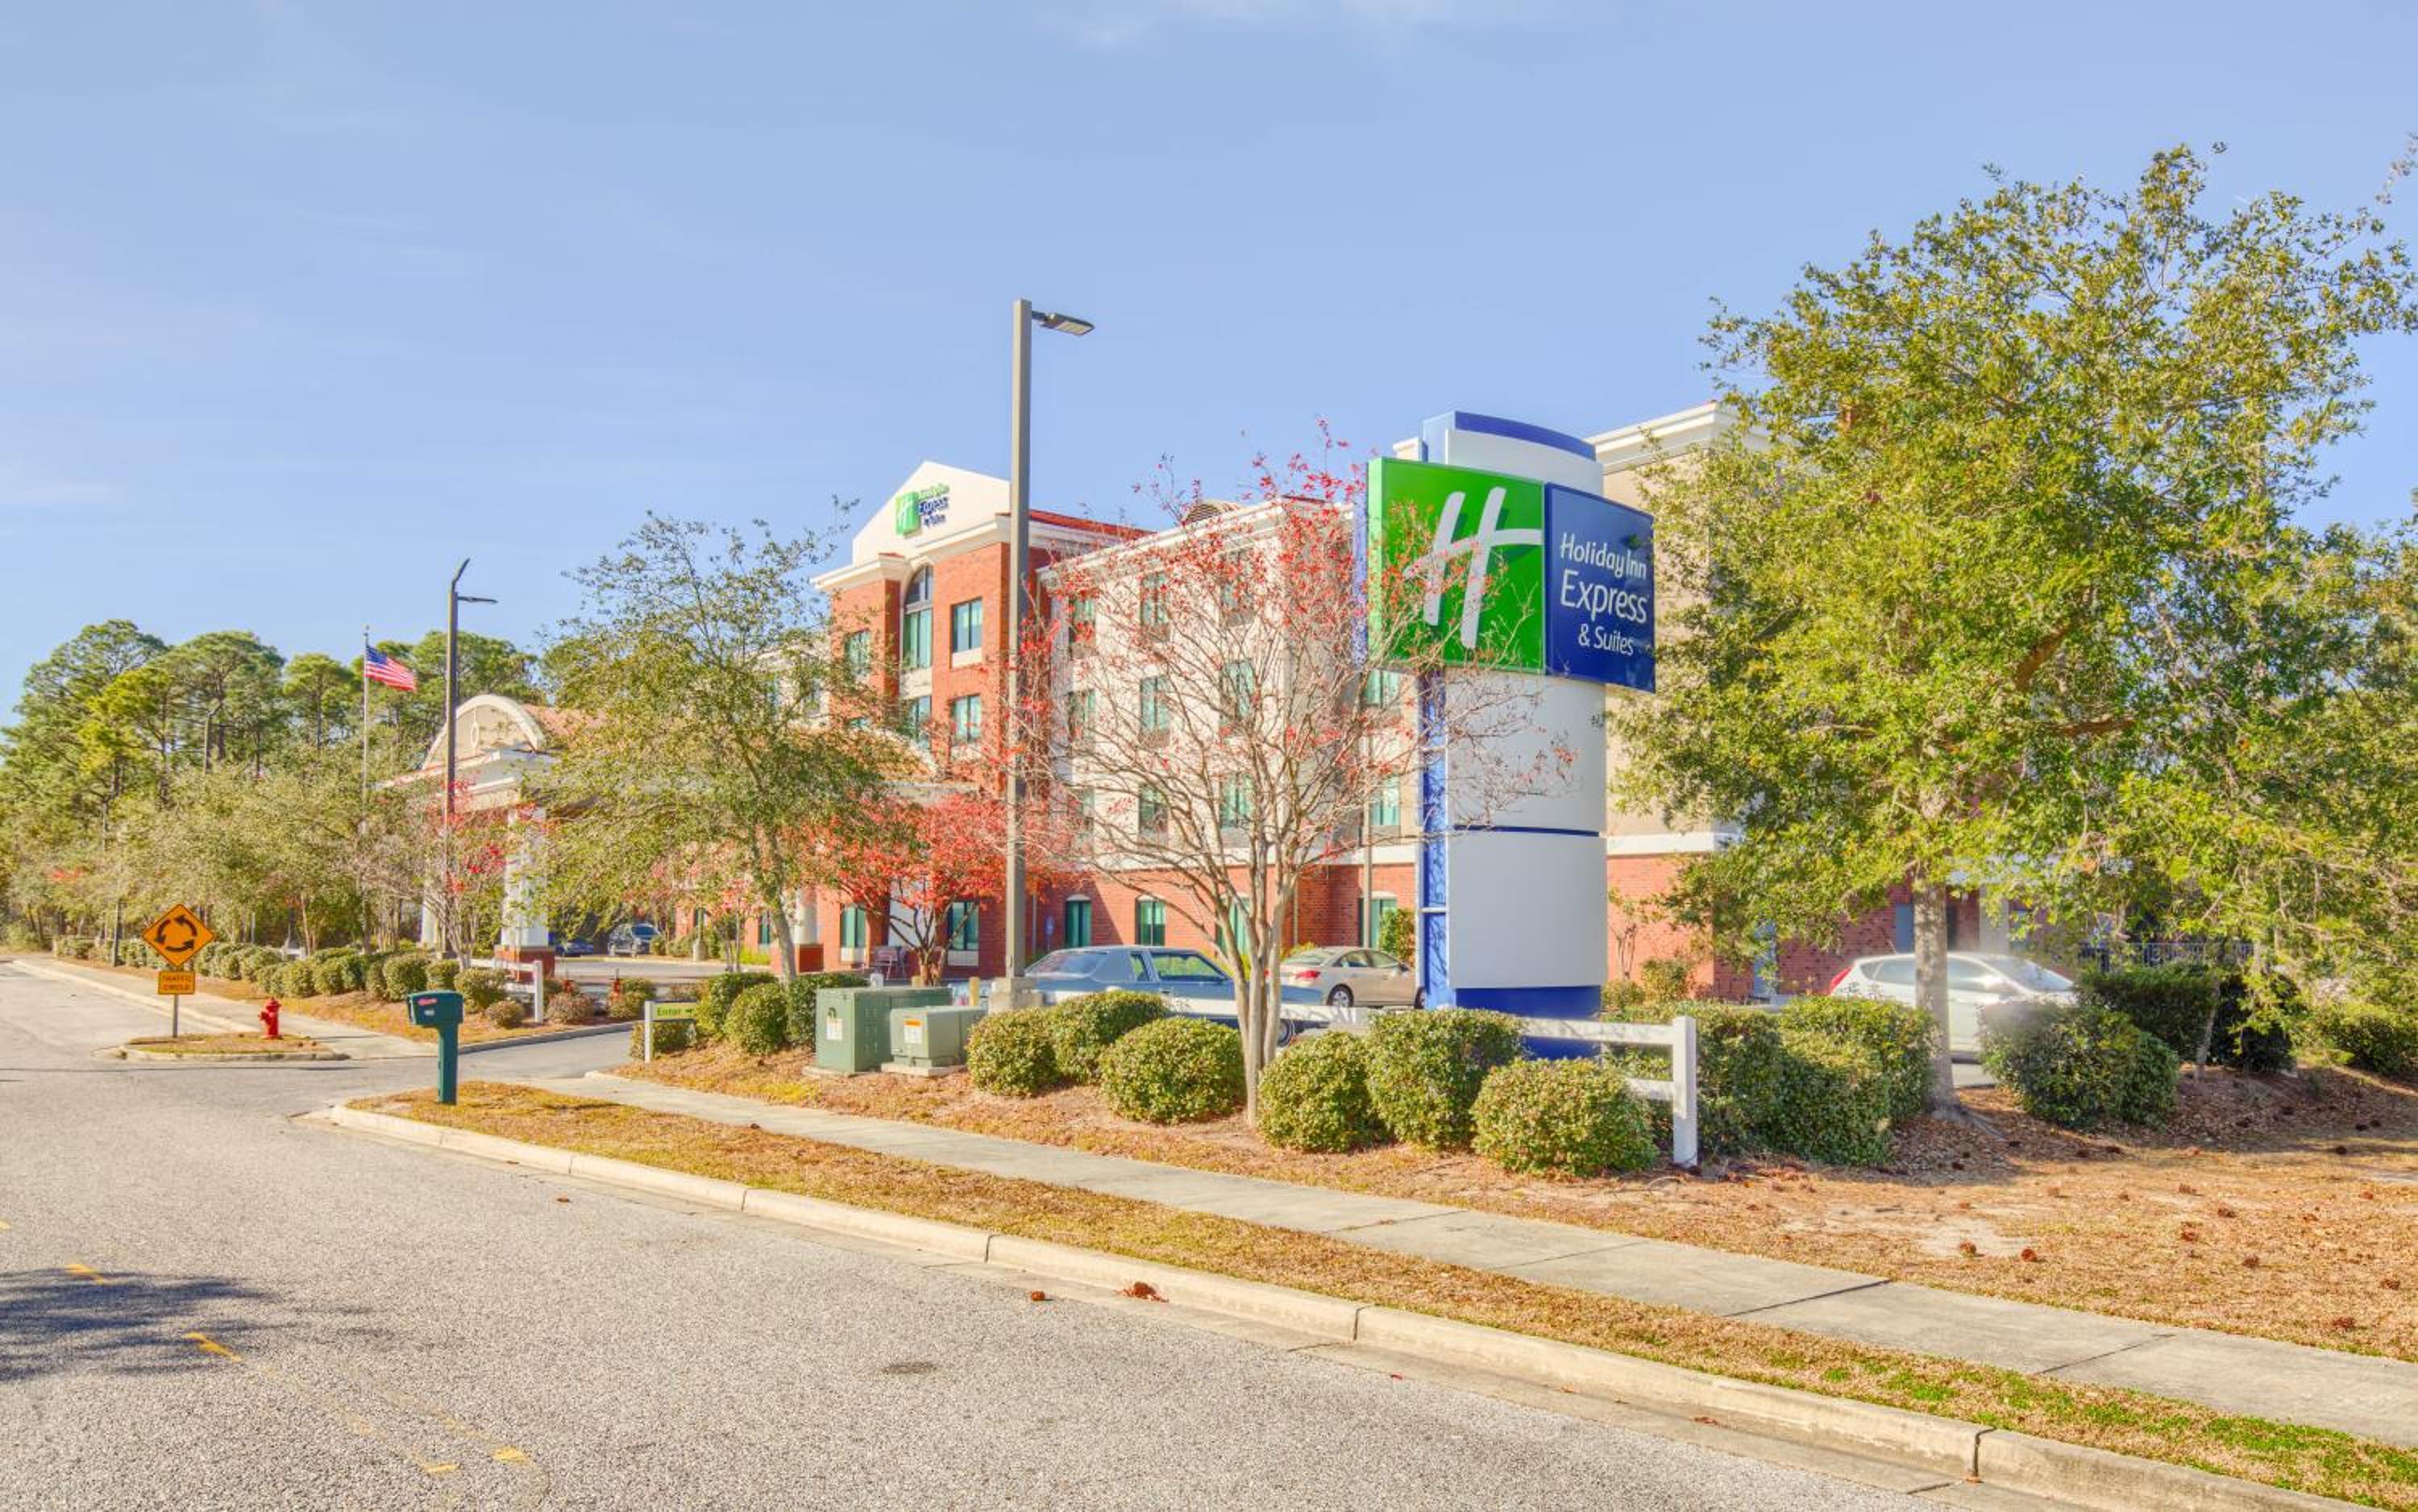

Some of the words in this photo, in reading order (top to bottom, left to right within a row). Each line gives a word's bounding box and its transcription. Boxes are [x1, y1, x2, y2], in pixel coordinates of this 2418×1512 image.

[1560, 532, 1624, 579] Holiday
[1627, 550, 1647, 579] Inn
[1560, 568, 1647, 624] Express
[1578, 623, 1590, 646] &
[1593, 625, 1635, 656] Suites
